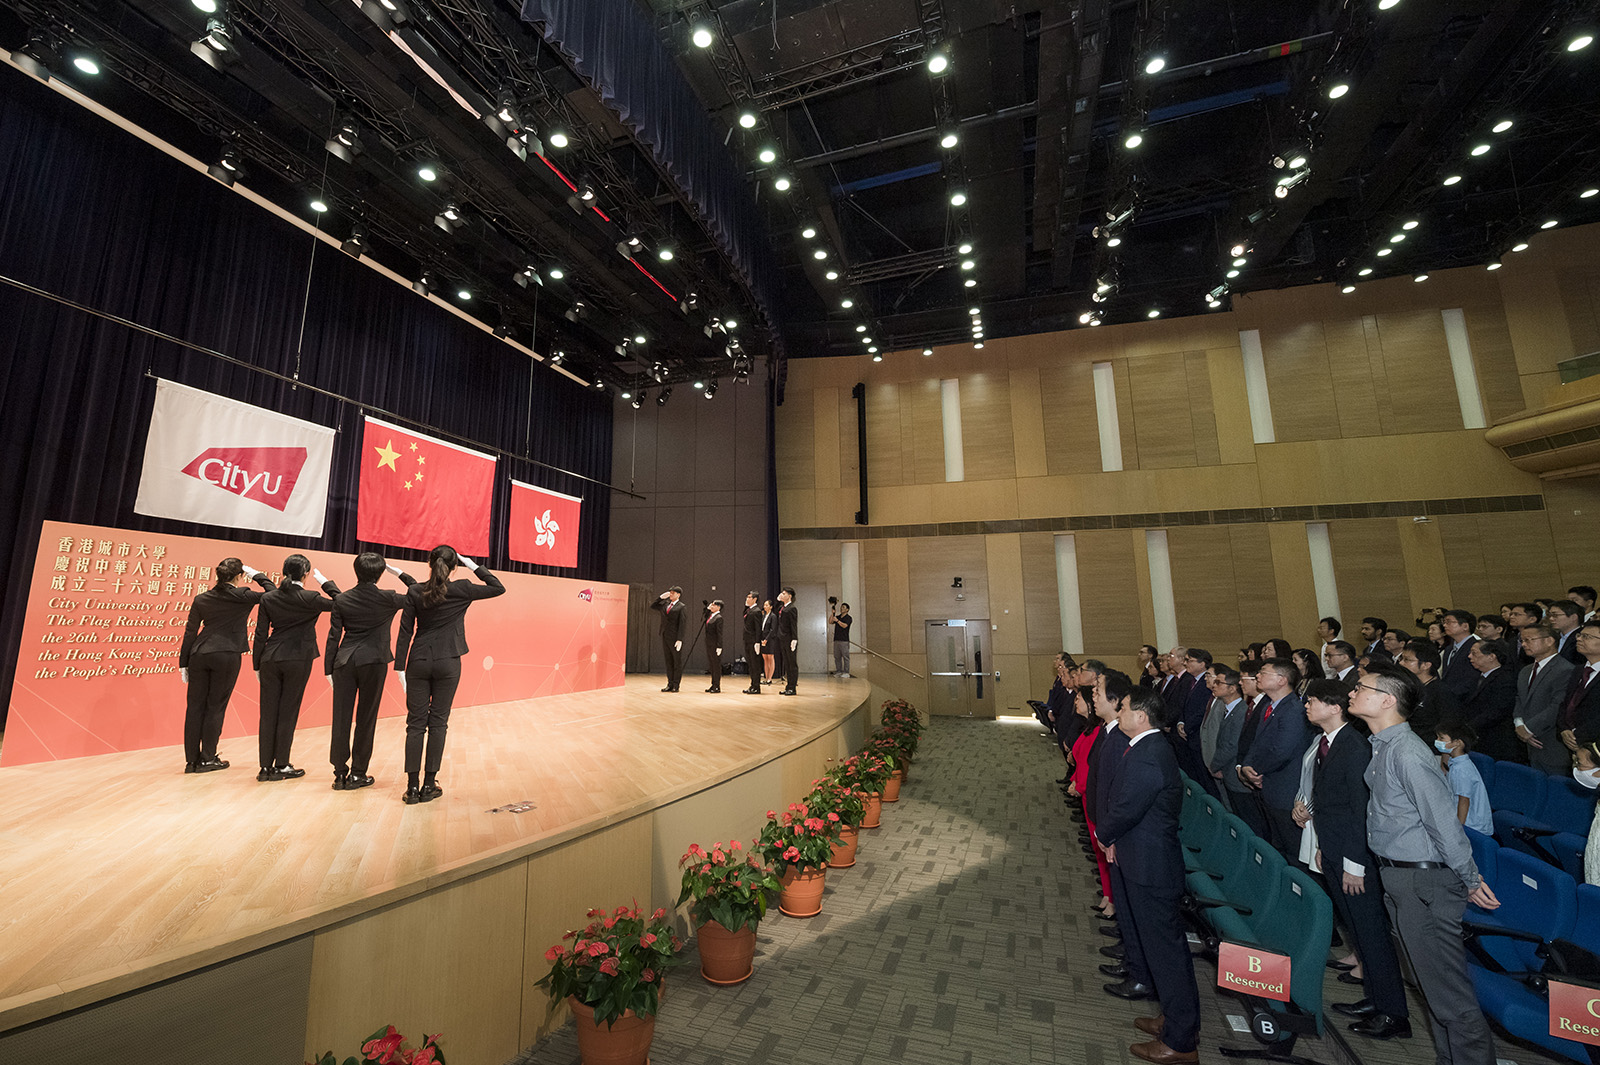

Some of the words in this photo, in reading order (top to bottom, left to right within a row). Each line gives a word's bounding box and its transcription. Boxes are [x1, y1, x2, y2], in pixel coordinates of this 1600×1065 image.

[198, 458, 282, 497] CityU
[58, 536, 166, 560] 香港城市大學
[48, 596, 79, 612] City
[84, 597, 153, 614] University
[155, 601, 171, 614] of
[174, 601, 191, 612] Ho
[46, 614, 74, 626] The
[78, 615, 111, 629] Flag
[115, 615, 165, 630] Raising
[41, 632, 63, 643] the
[66, 631, 98, 643] 26th
[101, 631, 181, 646] Anniversary
[38, 649, 60, 661] the
[64, 648, 103, 663] Hong
[108, 647, 143, 662] Kong
[146, 647, 180, 661] Speci
[34, 667, 57, 679] the
[61, 664, 118, 681] People’s
[121, 663, 175, 678] Republic
[1248, 955, 1262, 973] B
[1225, 971, 1283, 994] Reserved
[1261, 1020, 1275, 1035] B
[1559, 1016, 1600, 1037] Rese
